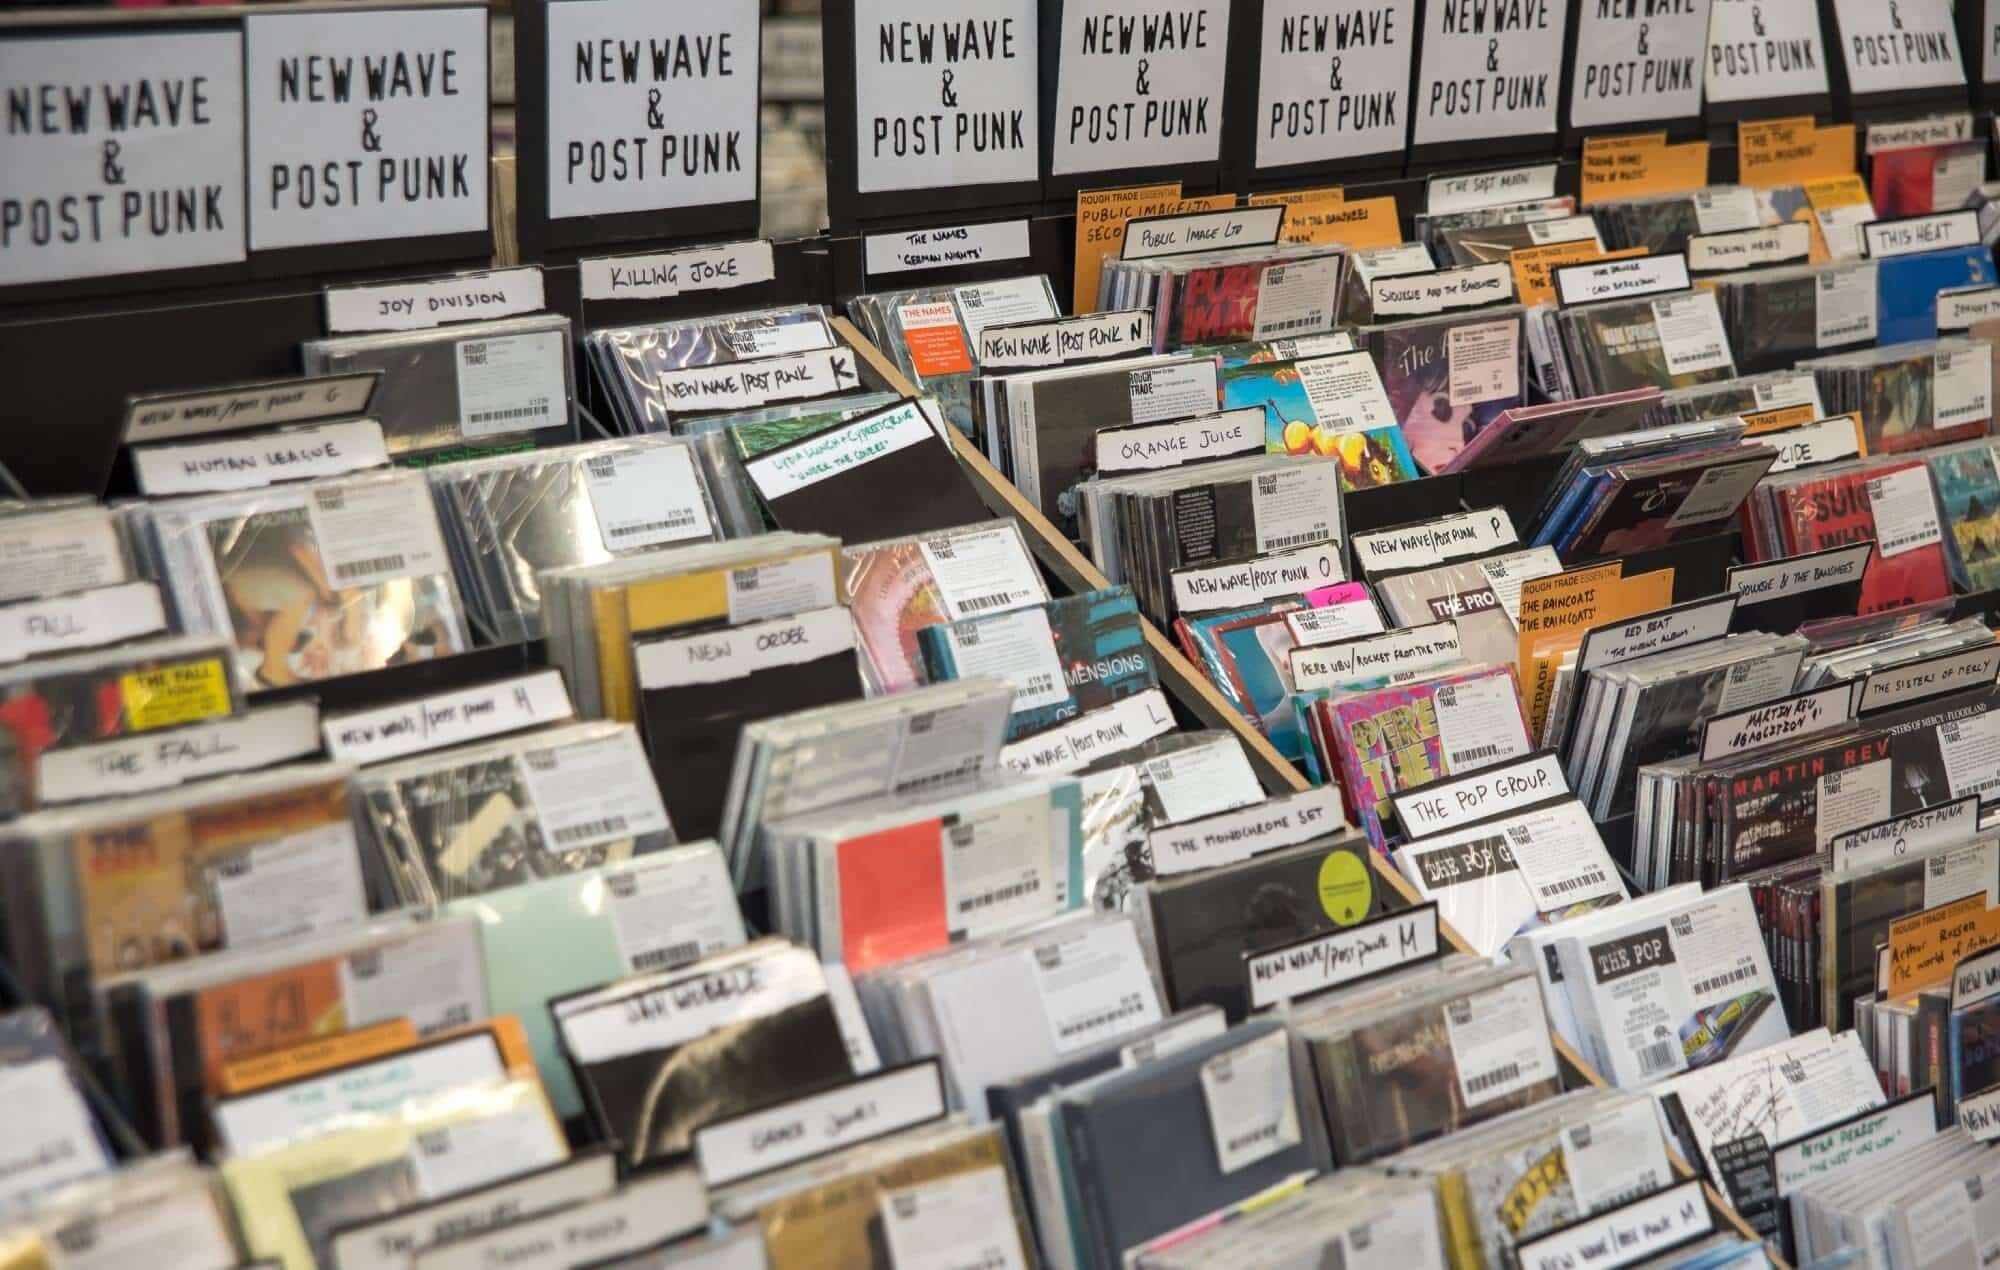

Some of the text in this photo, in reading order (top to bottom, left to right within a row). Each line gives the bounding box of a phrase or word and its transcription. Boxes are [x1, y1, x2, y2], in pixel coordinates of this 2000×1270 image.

[1082, 10, 1207, 55] NEW WAVE
[1281, 7, 1395, 54] NEW WAVE
[1442, 0, 1548, 35] NEW WAVE
[1752, 7, 1766, 38] &
[575, 32, 734, 84] NEW WAVE
[879, 17, 1015, 65] NEW WAVE
[1486, 38, 1499, 73] &
[1637, 23, 1650, 55] &
[1711, 38, 1815, 77] POST PUNK
[1853, 31, 1898, 67] POST
[1905, 31, 1952, 64] PUNK
[280, 49, 459, 103] NEW WAVE
[941, 69, 958, 108] &
[1135, 58, 1151, 96] &
[1330, 56, 1343, 91] &
[1585, 57, 1694, 99] POST PUNK
[8, 77, 212, 135] NEW WAVE
[646, 88, 665, 130] &
[1271, 91, 1397, 139] POST PUNK
[1429, 75, 1548, 117] POST PUNK
[361, 108, 382, 152] &
[874, 109, 1025, 158] POST PUNK
[1070, 96, 1209, 145] POST PUNK
[103, 139, 125, 185] &
[568, 130, 741, 184] POST PUNK
[272, 153, 470, 210] POST PUNK
[1080, 194, 1112, 205] ROUGH
[1112, 191, 1139, 201] TRADE
[1, 185, 224, 248] POST PUNK
[1877, 221, 1953, 246] THIS HEAT
[905, 228, 969, 246] THE NAMES
[1141, 228, 1176, 248] PUBLIC
[1186, 226, 1219, 244] IMAGE
[610, 257, 739, 291] KILLING JOKE
[379, 290, 507, 316] JOY DIVISION
[902, 304, 952, 319] THE NAMES
[984, 335, 1018, 359] NEW
[1020, 332, 1052, 355] WAVE
[1089, 325, 1123, 349] PUNK
[1130, 317, 1142, 343] N
[666, 381, 700, 400] NEW
[701, 376, 740, 396] WAVE
[775, 365, 814, 388] PUNK
[830, 354, 855, 391] K
[1129, 370, 1153, 385] ROUGH
[1400, 345, 1435, 377] The
[1130, 382, 1154, 397] TRADE
[1756, 415, 1777, 427] TRADE
[1121, 426, 1244, 461] ORANGE JUICE
[183, 456, 257, 476] HUMAN
[1370, 537, 1398, 555] NEW
[1490, 516, 1502, 539] P
[1186, 576, 1220, 595] NEW
[1281, 566, 1310, 584] PUNK
[1319, 556, 1331, 578] O
[1523, 582, 1553, 596] ROUGH
[1554, 575, 1580, 590] TRADE
[1432, 598, 1461, 618] THE
[1521, 588, 1597, 613] THE RAINCOATS
[688, 626, 809, 662] NEW ORDER
[1300, 659, 1327, 678] PERE
[1873, 682, 1891, 695] THE
[1894, 672, 1936, 692] SISTERS
[1098, 725, 1129, 745] PUNK
[1147, 703, 1167, 727] L
[1732, 739, 1890, 798] MARTIN REV
[1411, 798, 1449, 824] THE
[1455, 785, 1488, 813] POP
[1169, 806, 1324, 855] THE MONOCHROME SET
[1843, 830, 1871, 852] NEW
[1935, 805, 1965, 824] PUNK
[1424, 854, 1461, 883] THE
[1463, 844, 1492, 874] POP
[1254, 958, 1287, 981] NEW
[1398, 920, 1418, 957] M
[1599, 937, 1664, 977] THE POP
[1958, 969, 1982, 997] NEW
[1961, 1107, 1990, 1131] NEW
